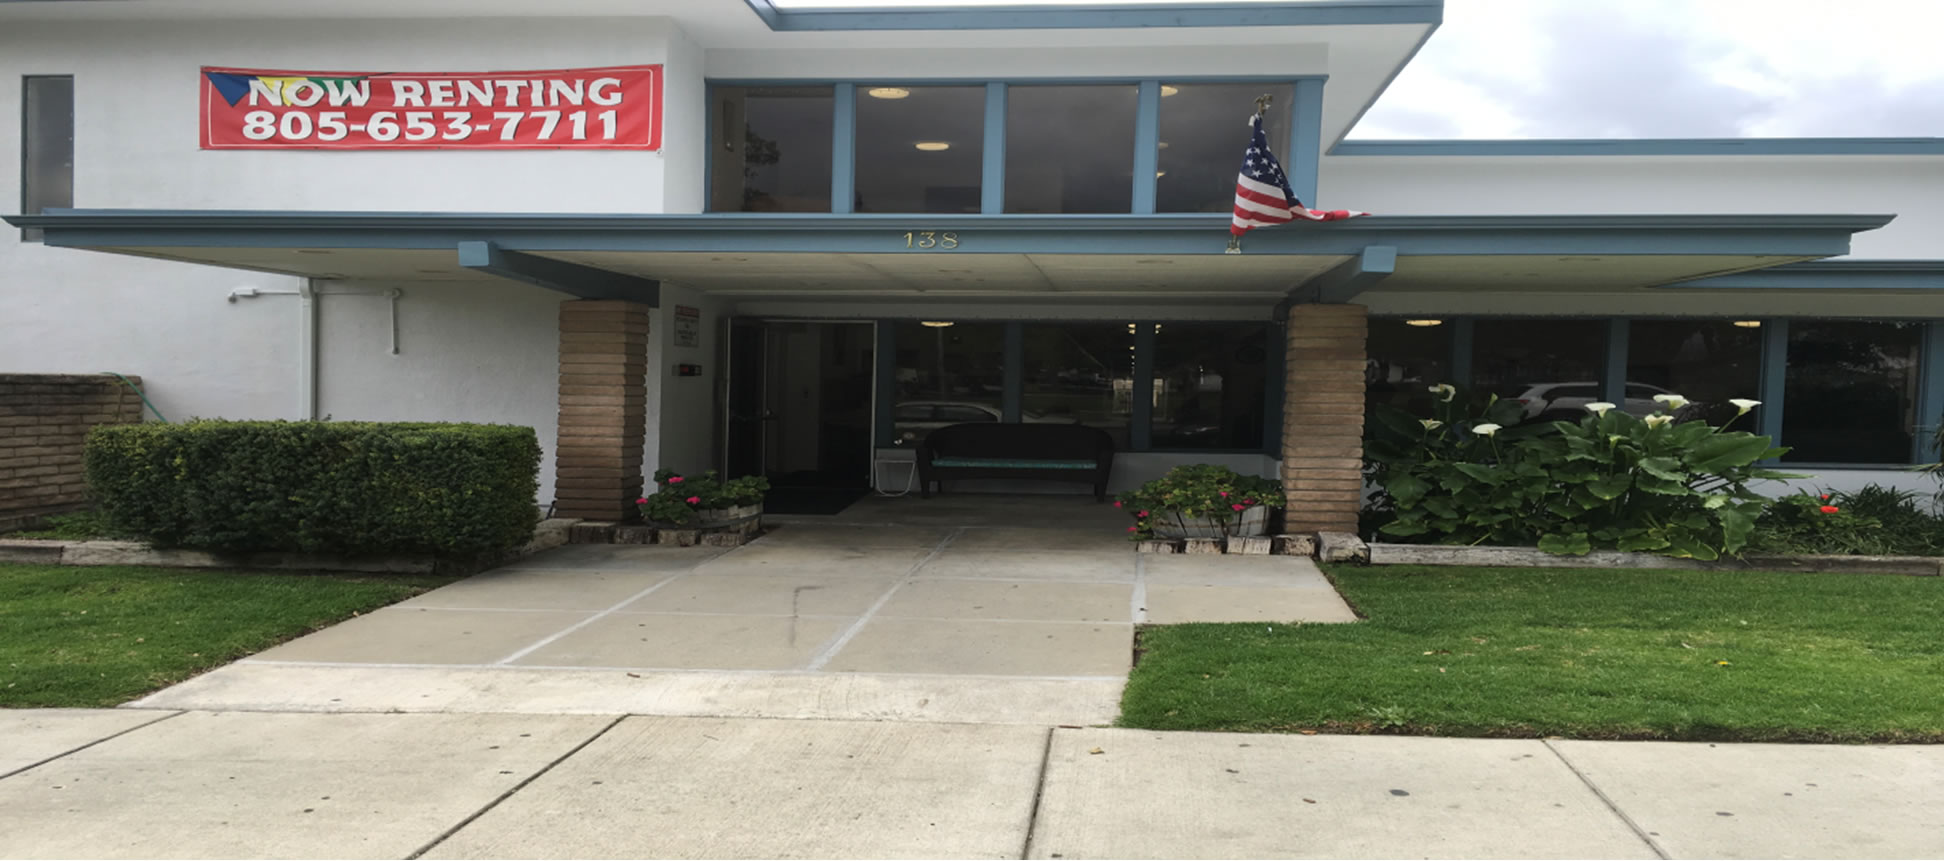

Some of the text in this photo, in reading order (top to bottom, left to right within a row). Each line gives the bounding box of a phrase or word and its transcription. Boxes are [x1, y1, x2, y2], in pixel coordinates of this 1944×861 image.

[248, 78, 624, 107] NOW RENTING
[243, 110, 618, 141] 805-653-7711
[903, 232, 959, 249] 138
